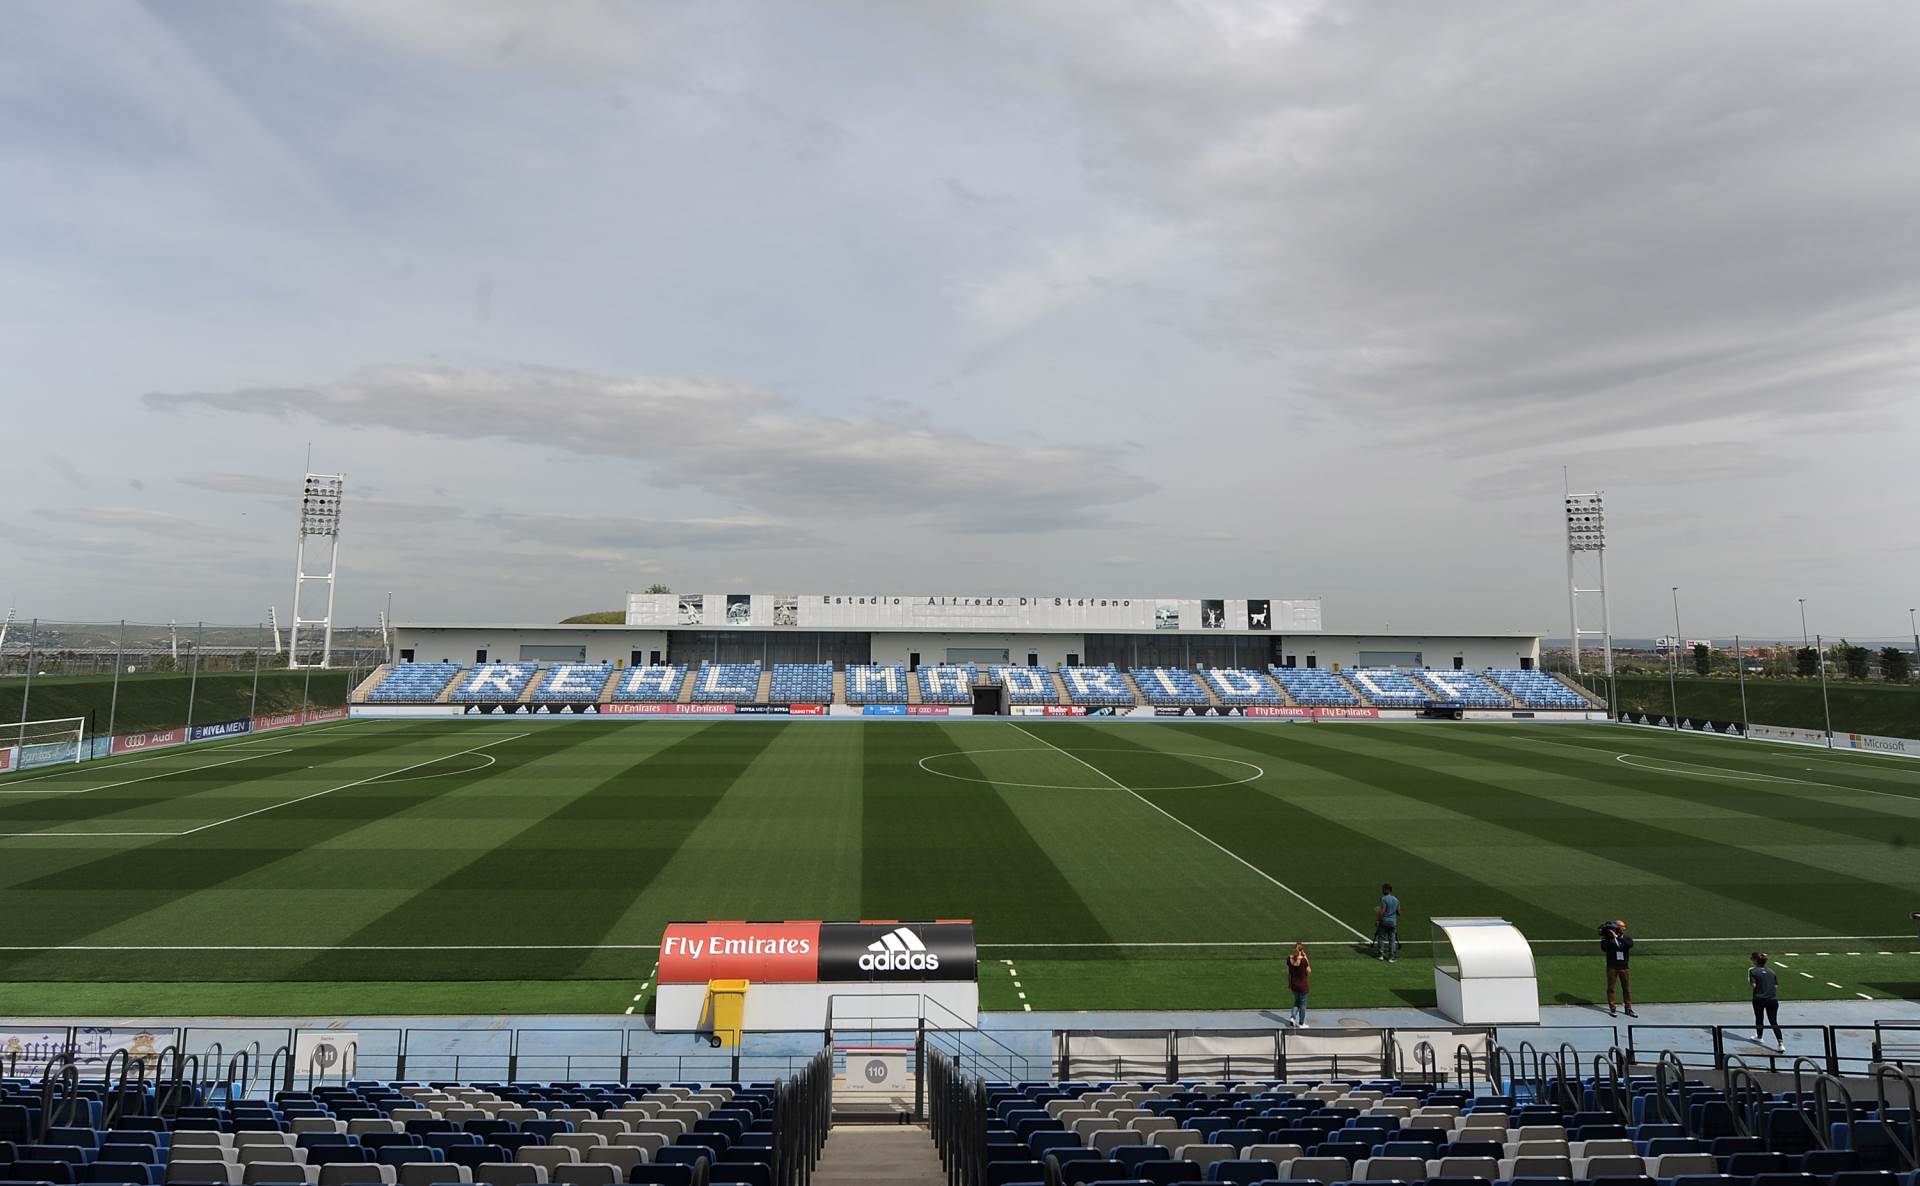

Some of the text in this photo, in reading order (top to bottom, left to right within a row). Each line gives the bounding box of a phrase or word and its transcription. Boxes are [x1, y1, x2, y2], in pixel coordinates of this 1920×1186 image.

[824, 596, 900, 605] Estadio
[928, 597, 1004, 606] Alfredo
[1020, 597, 1036, 606] Di
[468, 665, 1470, 698] REAL MADRID CF
[610, 704, 660, 713] Fly Emirates
[677, 704, 728, 713] Fly Emirates
[1255, 707, 1304, 715] Fly Emirates
[1321, 707, 1371, 716] Fly Emirates
[203, 721, 246, 737] NIVEA MEN
[152, 732, 174, 743] Audi
[1864, 738, 1905, 751] Microsoft
[665, 936, 810, 959] Fly Emirates
[859, 949, 939, 970] adidas
[868, 1066, 885, 1077] 110
